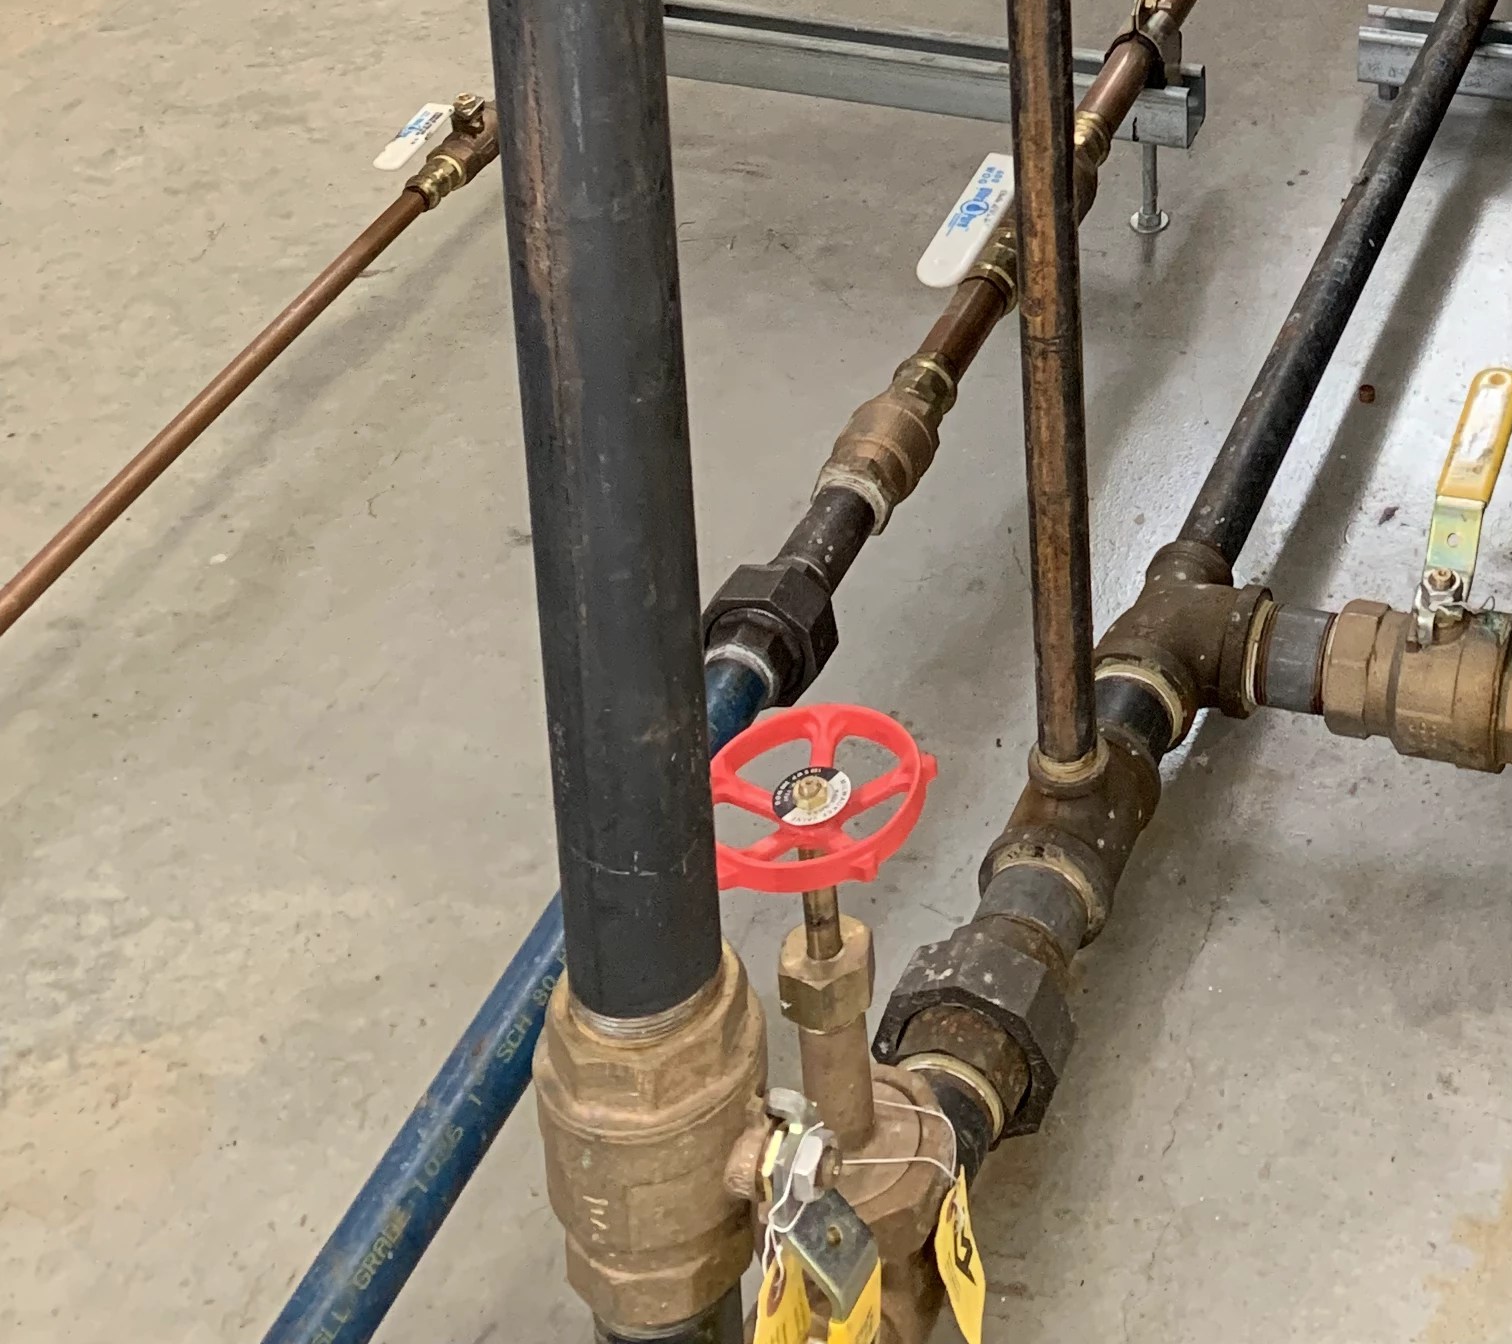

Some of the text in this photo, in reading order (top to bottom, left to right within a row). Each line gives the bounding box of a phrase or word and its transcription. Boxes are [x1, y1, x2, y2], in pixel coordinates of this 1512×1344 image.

[352, 1205, 412, 1290] GRADE
[496, 1013, 533, 1064] SCH
[532, 974, 557, 1007] 80
